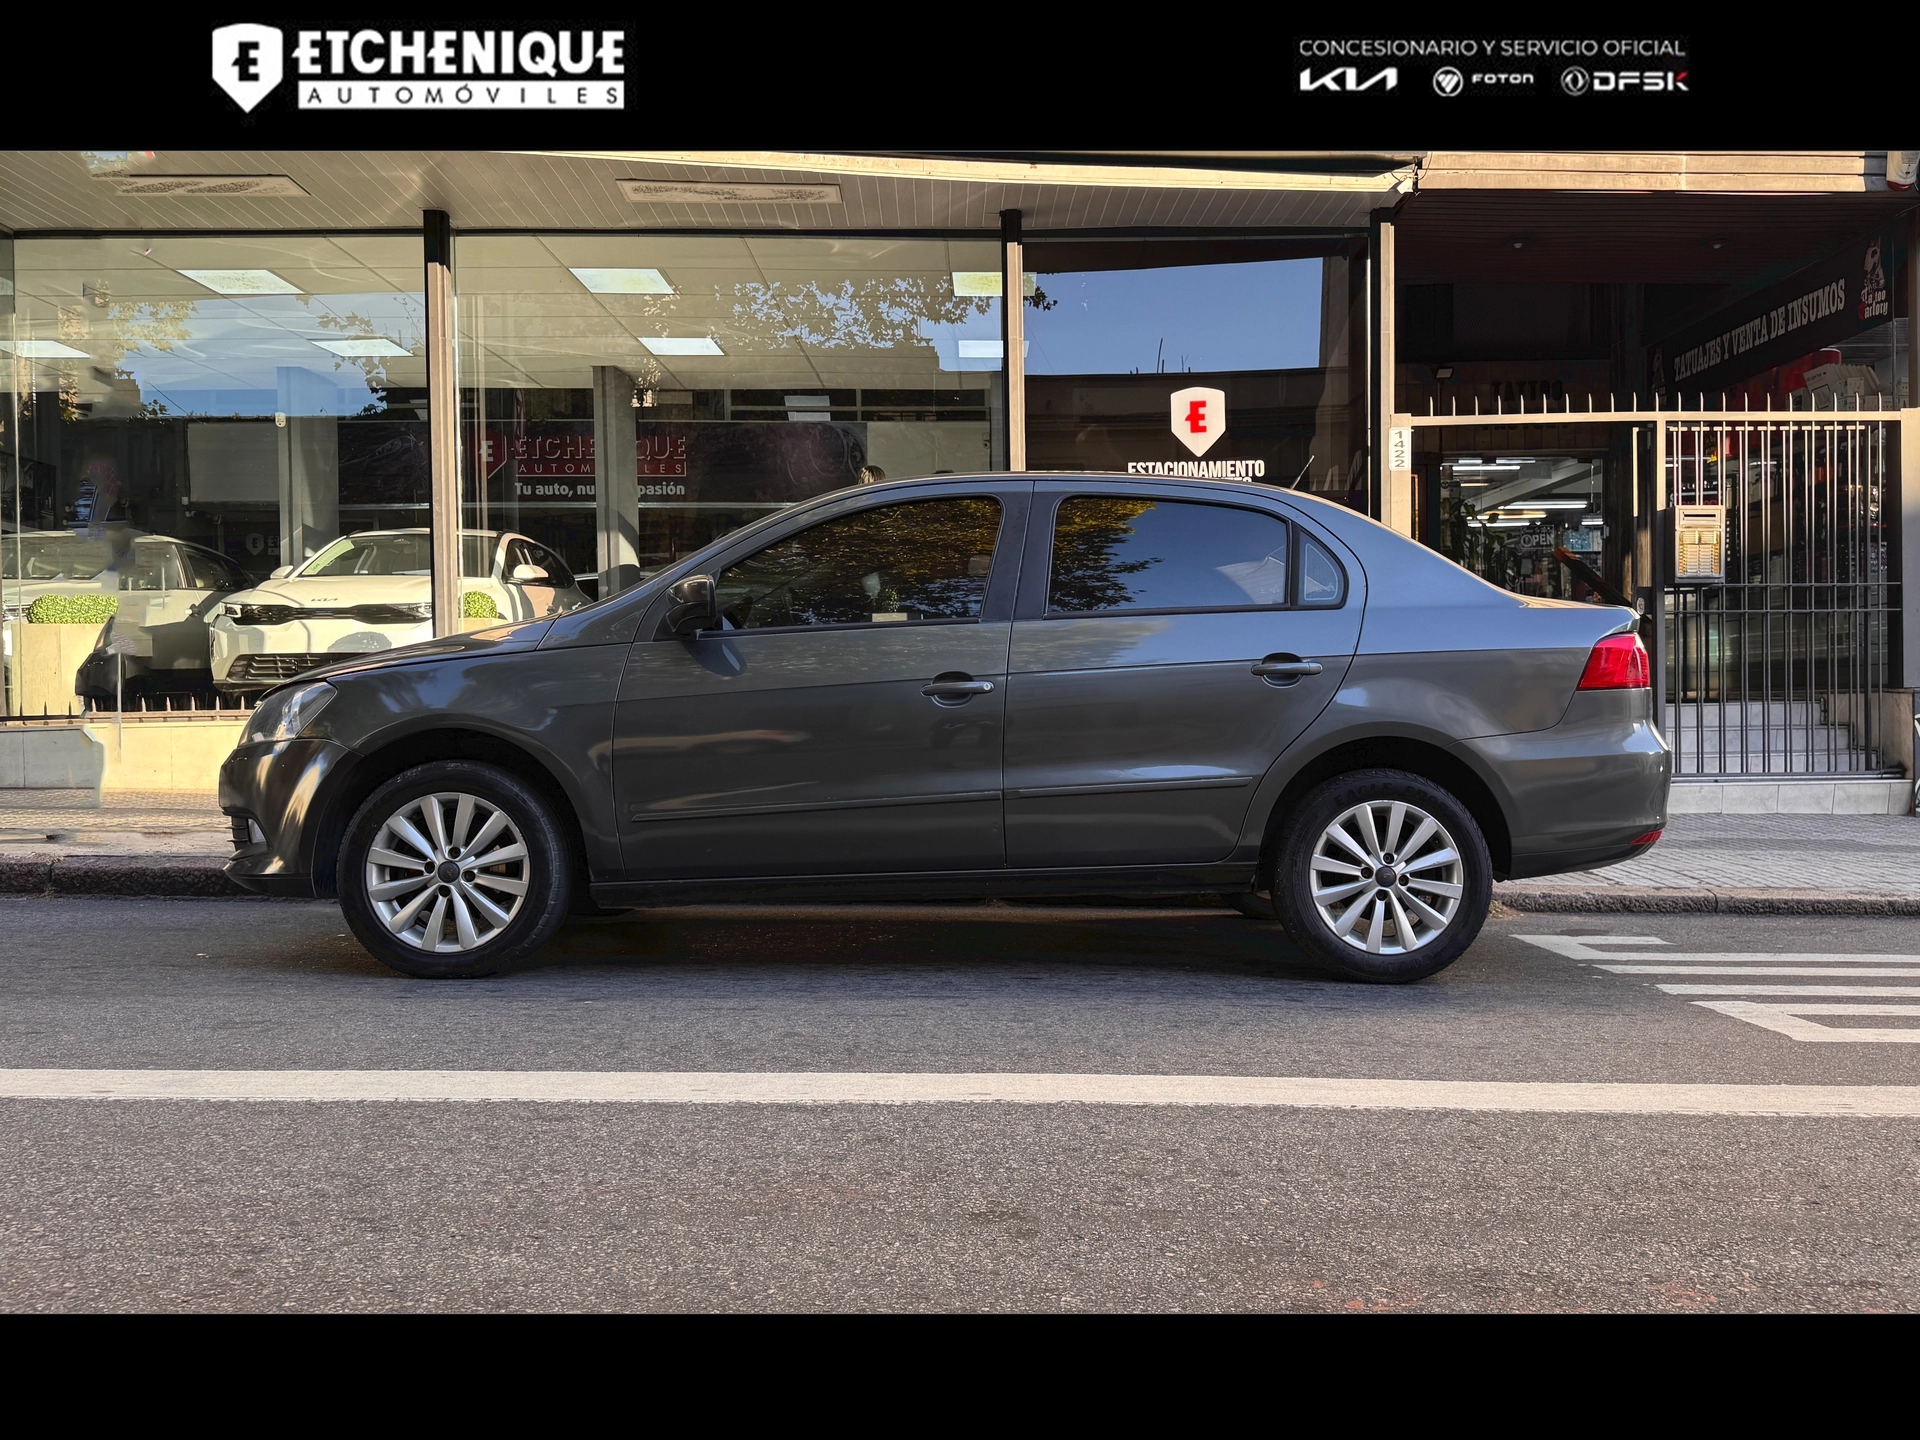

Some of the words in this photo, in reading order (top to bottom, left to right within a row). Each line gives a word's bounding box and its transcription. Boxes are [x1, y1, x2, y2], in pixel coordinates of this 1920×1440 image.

[1674, 336, 1722, 382] TATUAJES
[1721, 332, 1731, 360] Y
[1731, 314, 1769, 355] VENTA
[1770, 305, 1786, 340] DE
[1787, 278, 1845, 332] INSUMOS
[511, 436, 686, 460] ETCHEQUE
[1394, 430, 1406, 468] 1422
[518, 463, 682, 474] AUTOMLES
[1127, 460, 1265, 478] ESTACIONAMIENTO
[514, 482, 531, 495] Tu
[535, 484, 573, 497] auto,
[638, 482, 685, 497] pasión
[1521, 533, 1553, 547] OPEN
